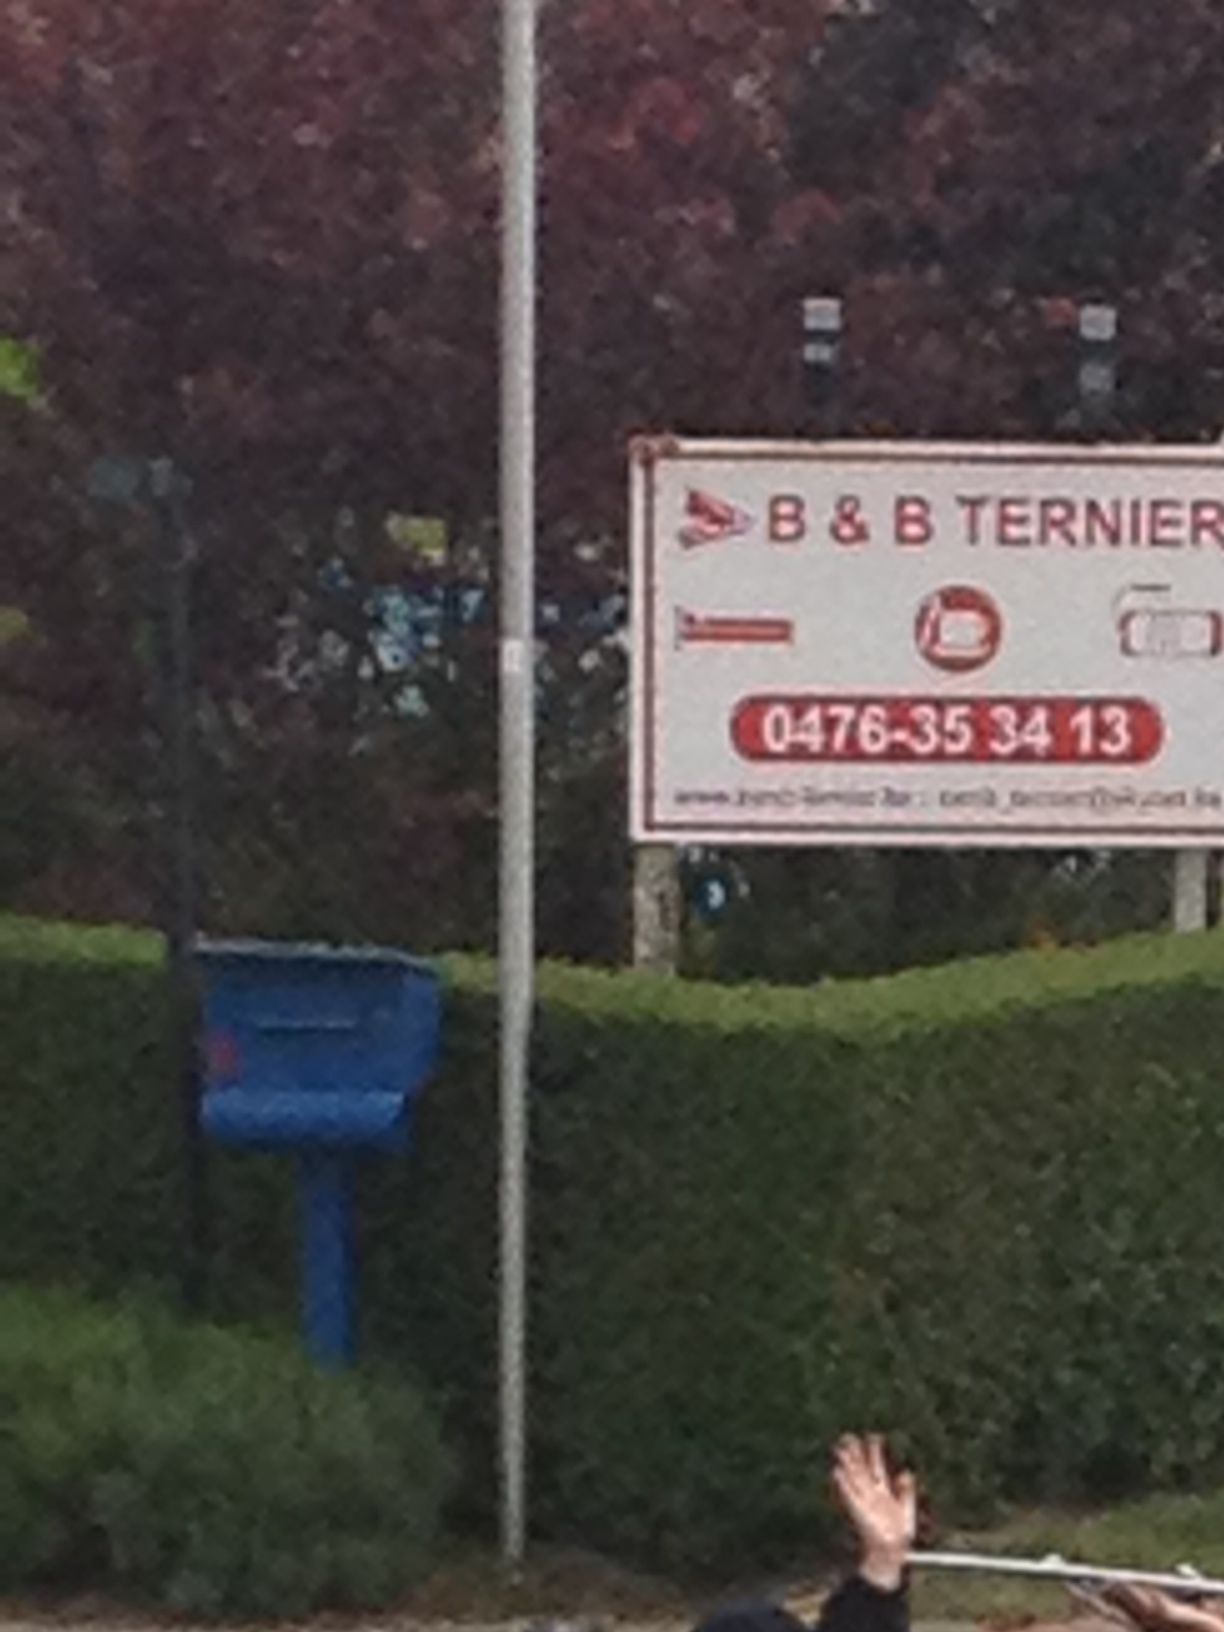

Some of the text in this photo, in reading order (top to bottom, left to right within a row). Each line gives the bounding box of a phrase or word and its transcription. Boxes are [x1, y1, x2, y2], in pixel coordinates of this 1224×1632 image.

[768, 496, 806, 543] B
[830, 496, 869, 545] &
[894, 496, 933, 544] B
[762, 705, 1131, 755] 0476-35 34 13
